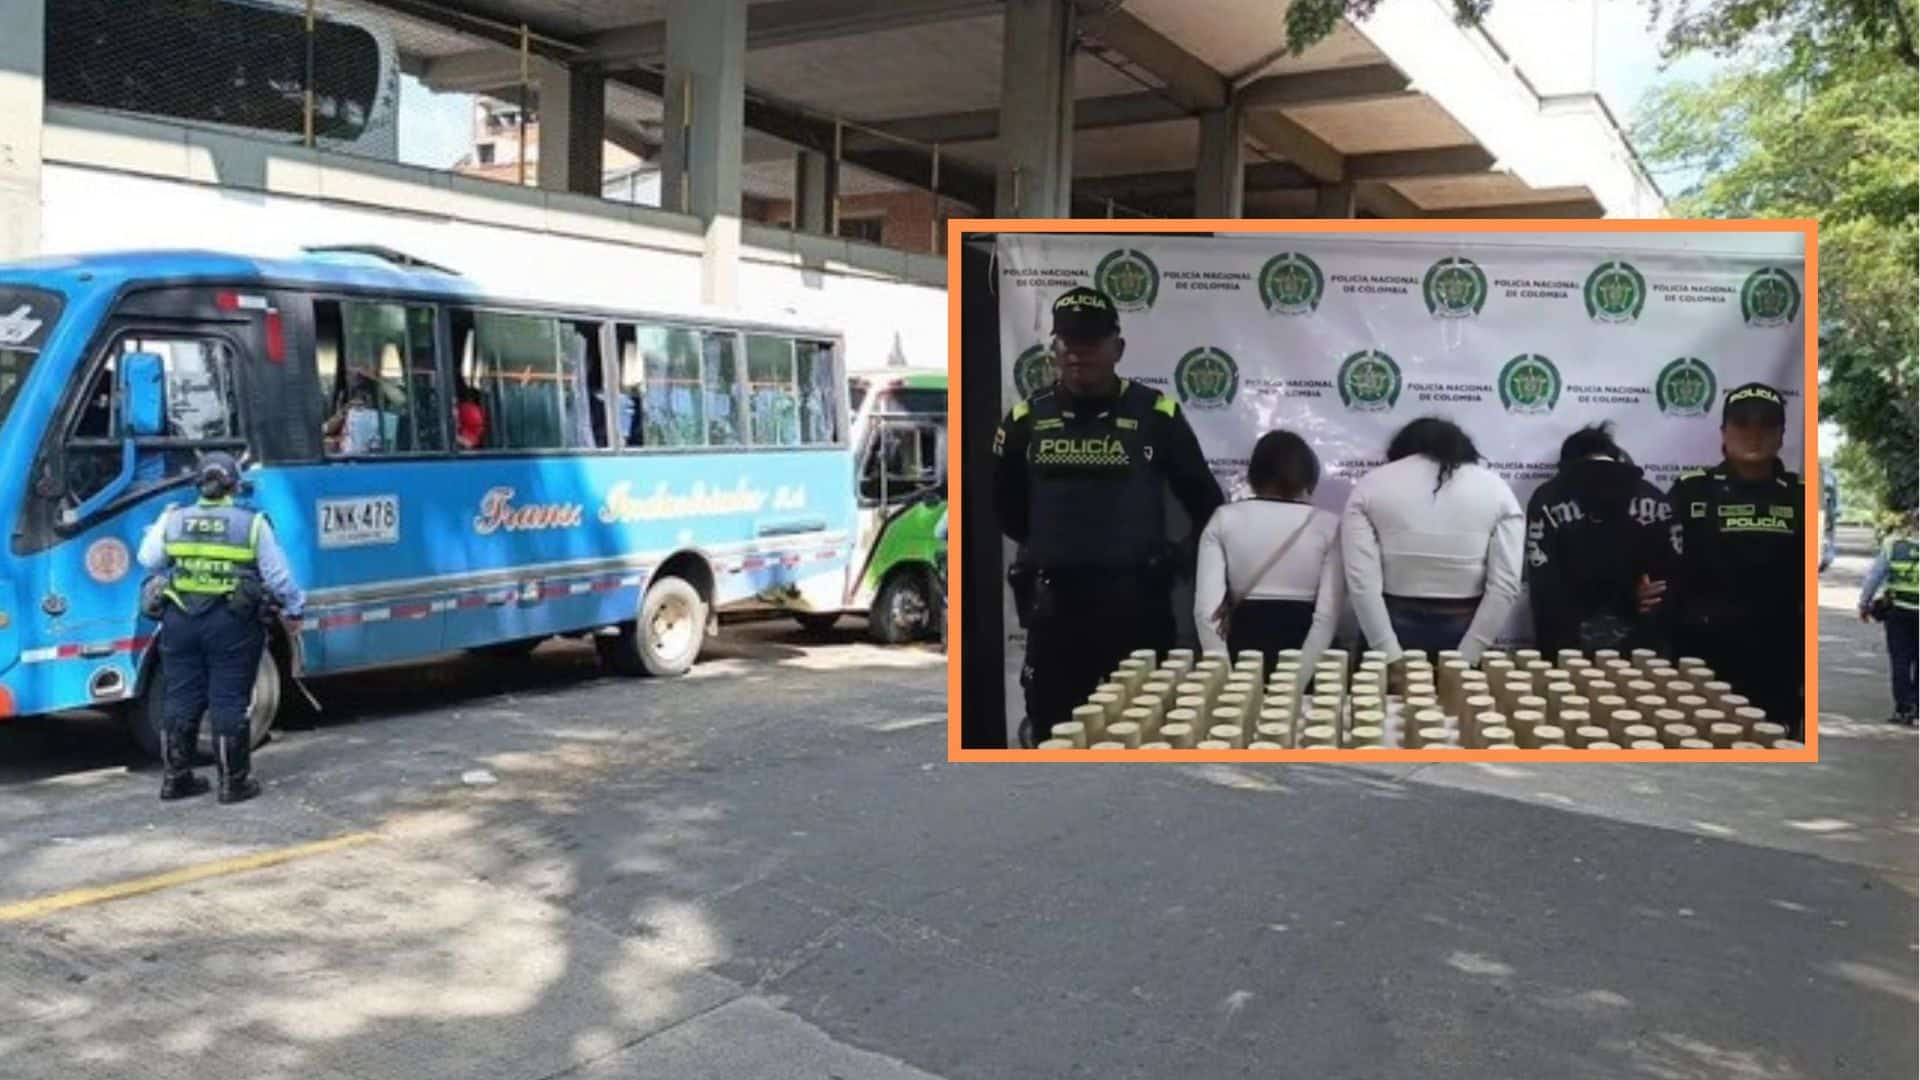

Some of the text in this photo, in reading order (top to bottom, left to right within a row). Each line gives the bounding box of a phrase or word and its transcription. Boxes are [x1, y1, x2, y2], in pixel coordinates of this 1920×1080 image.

[1040, 268, 1088, 277] NACIONAL
[1203, 271, 1250, 280] NACIONAL
[1016, 279, 1078, 287] DE COLOMBIA
[1371, 275, 1418, 285] NACIONAL
[1533, 280, 1579, 289] NACIONAL
[1176, 281, 1240, 290] DE COLOMBIA
[1343, 284, 1408, 295] DE COLOMBIA
[1691, 285, 1736, 294] NACIONAL
[1505, 289, 1568, 299] DE COLOMBIA
[1664, 294, 1727, 304] DE COLOMBIA
[1446, 384, 1493, 393] NACIONAL
[1604, 386, 1651, 395] NACIONAL
[1418, 393, 1482, 402] DE COLOMBIA
[1578, 395, 1639, 404] DE COLOMBIA
[1040, 434, 1126, 454] POLICÍA
